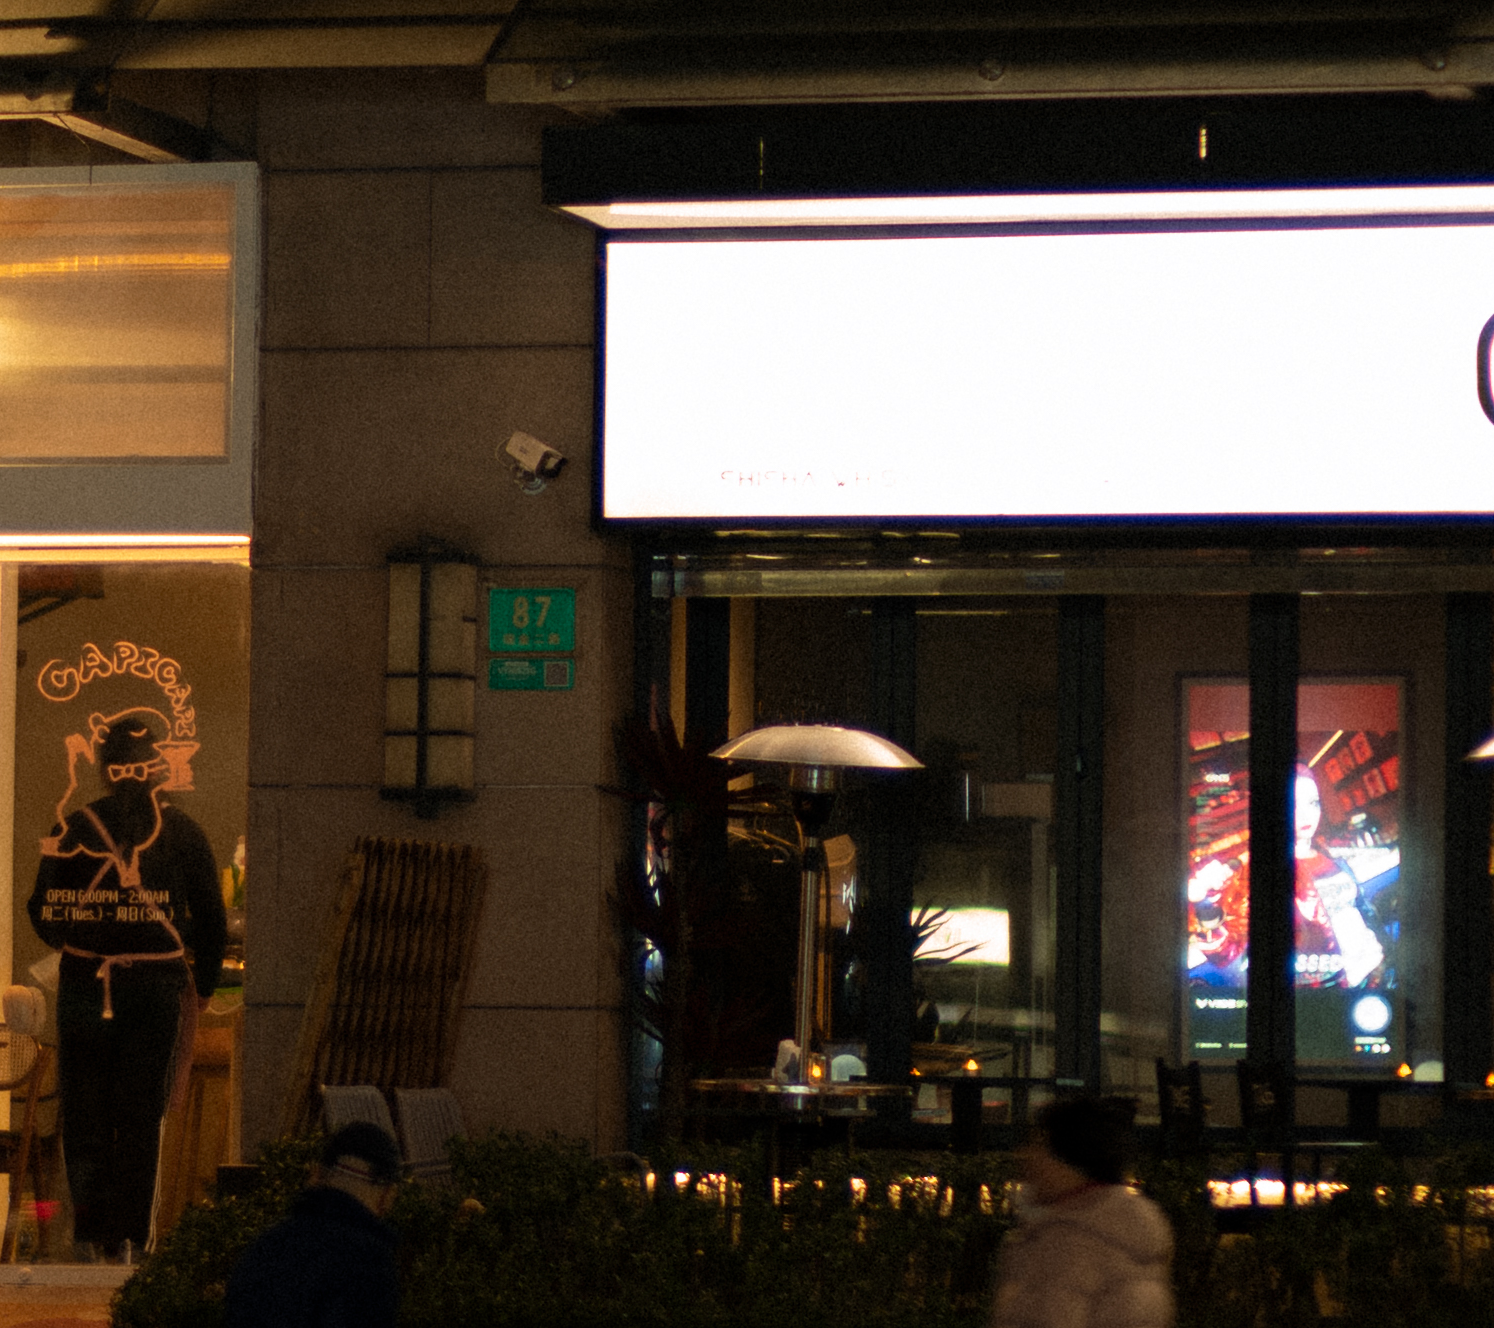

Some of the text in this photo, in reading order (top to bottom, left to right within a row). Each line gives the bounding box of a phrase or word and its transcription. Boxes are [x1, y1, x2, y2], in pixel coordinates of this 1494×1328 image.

[512, 595, 552, 629] 87
[46, 889, 76, 903] OPEN
[77, 889, 119, 903] 6:00PM
[129, 889, 169, 904] 2:00AM
